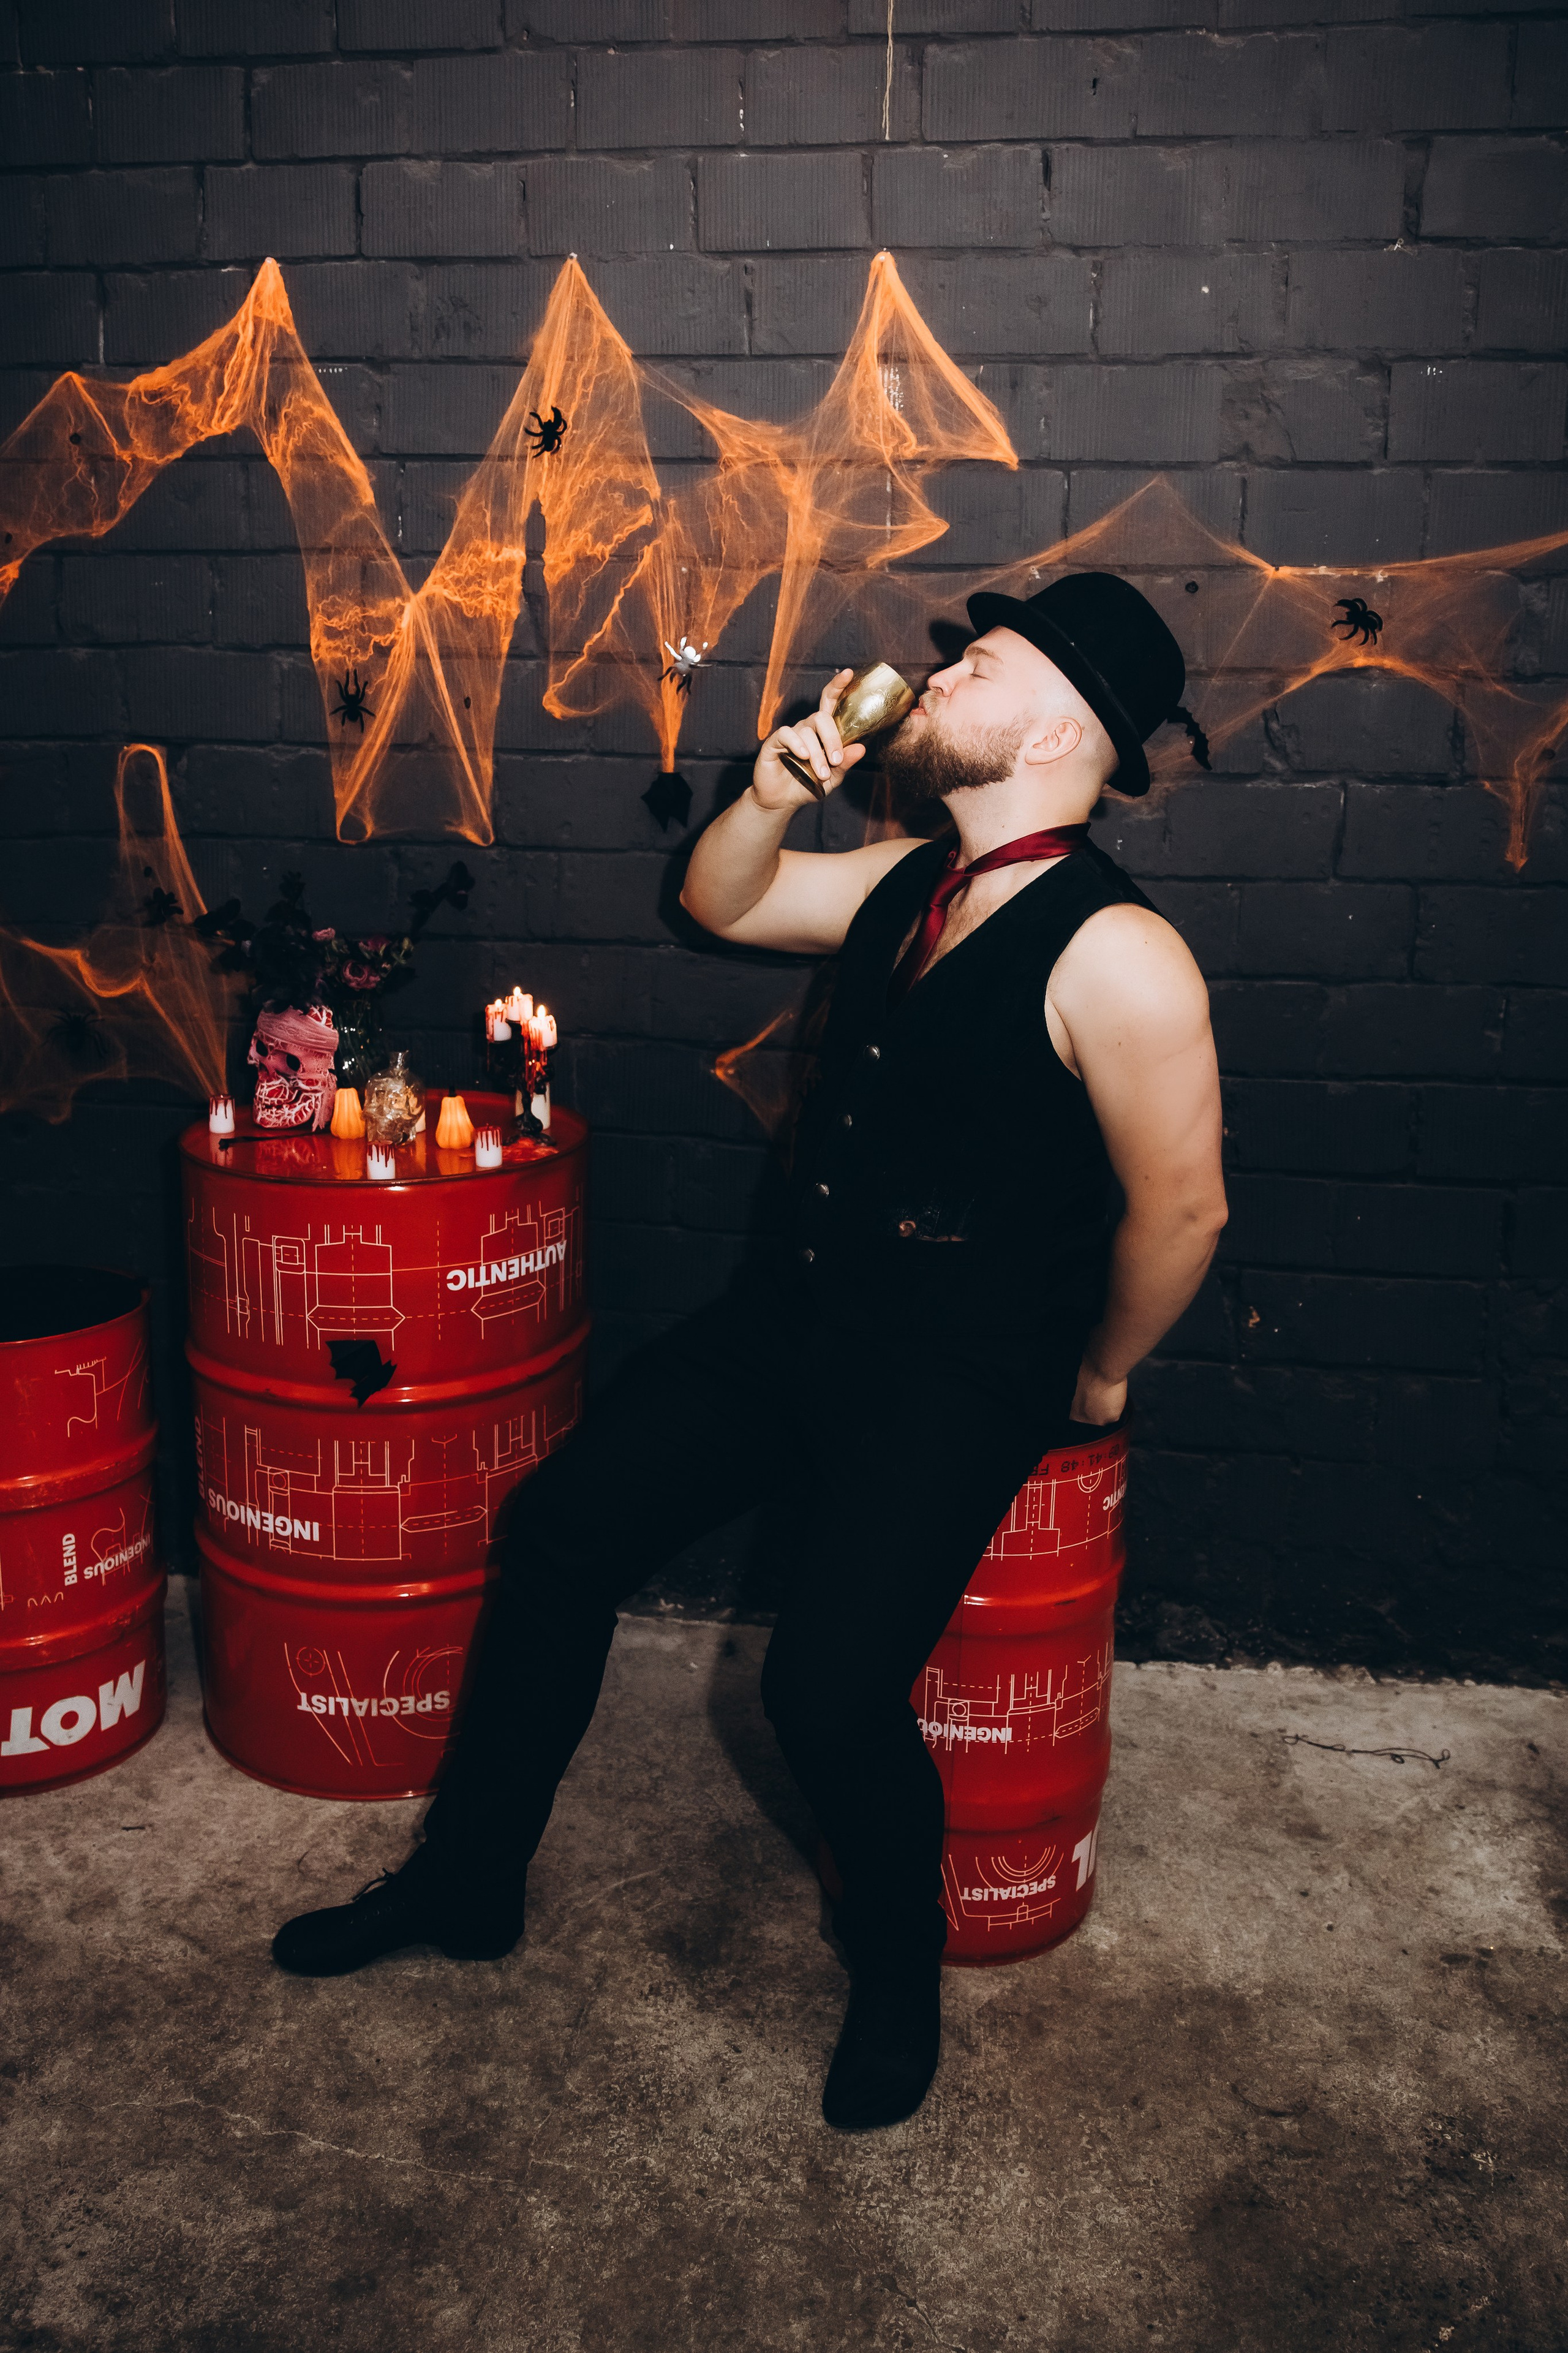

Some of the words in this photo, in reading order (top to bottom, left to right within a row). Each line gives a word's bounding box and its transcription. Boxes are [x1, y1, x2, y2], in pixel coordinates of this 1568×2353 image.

[446, 1240, 567, 1291] AUTHENTIC
[194, 1415, 205, 1500] BLEND
[208, 1488, 319, 1542] INGENIOUS
[62, 1533, 78, 1587] BLEND
[83, 1533, 151, 1580] INGENIOUS
[1, 1660, 146, 1757] MOT
[297, 1690, 450, 1717] SPECIALIST
[960, 1875, 1057, 1902] SPECIALIST
